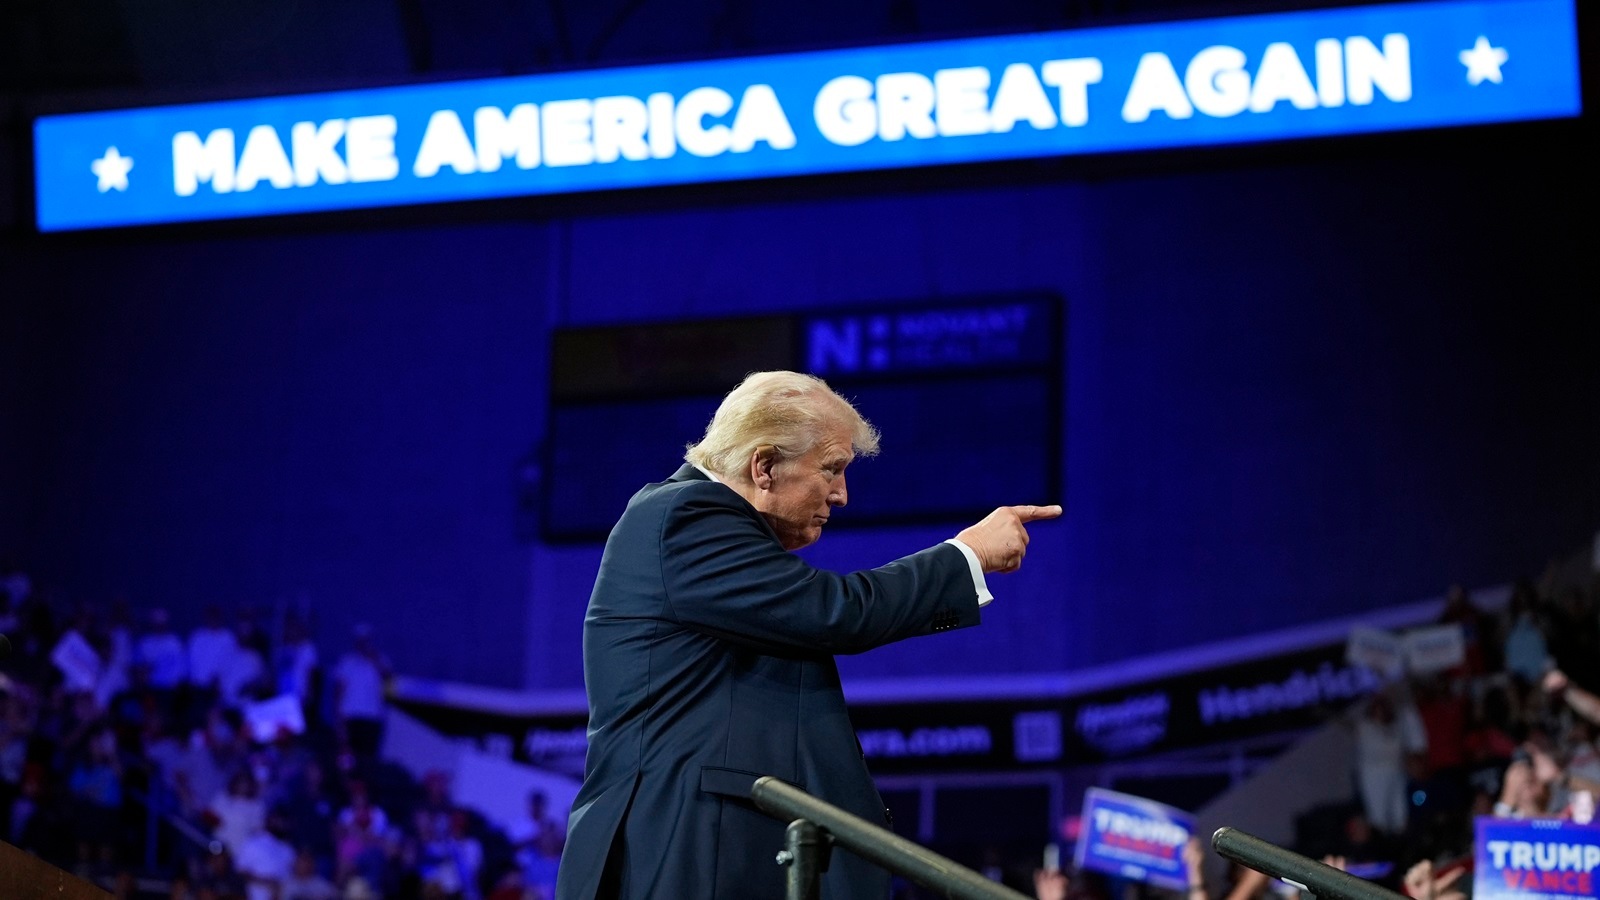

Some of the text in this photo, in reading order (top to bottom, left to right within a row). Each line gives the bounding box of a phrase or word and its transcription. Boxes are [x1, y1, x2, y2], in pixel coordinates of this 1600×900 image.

[173, 34, 1411, 196] MAKE AMERICA GREAT AGAIN
[1093, 806, 1190, 848] TRUMP
[1486, 840, 1600, 874] TRUMP
[1503, 867, 1593, 895] VANCE
